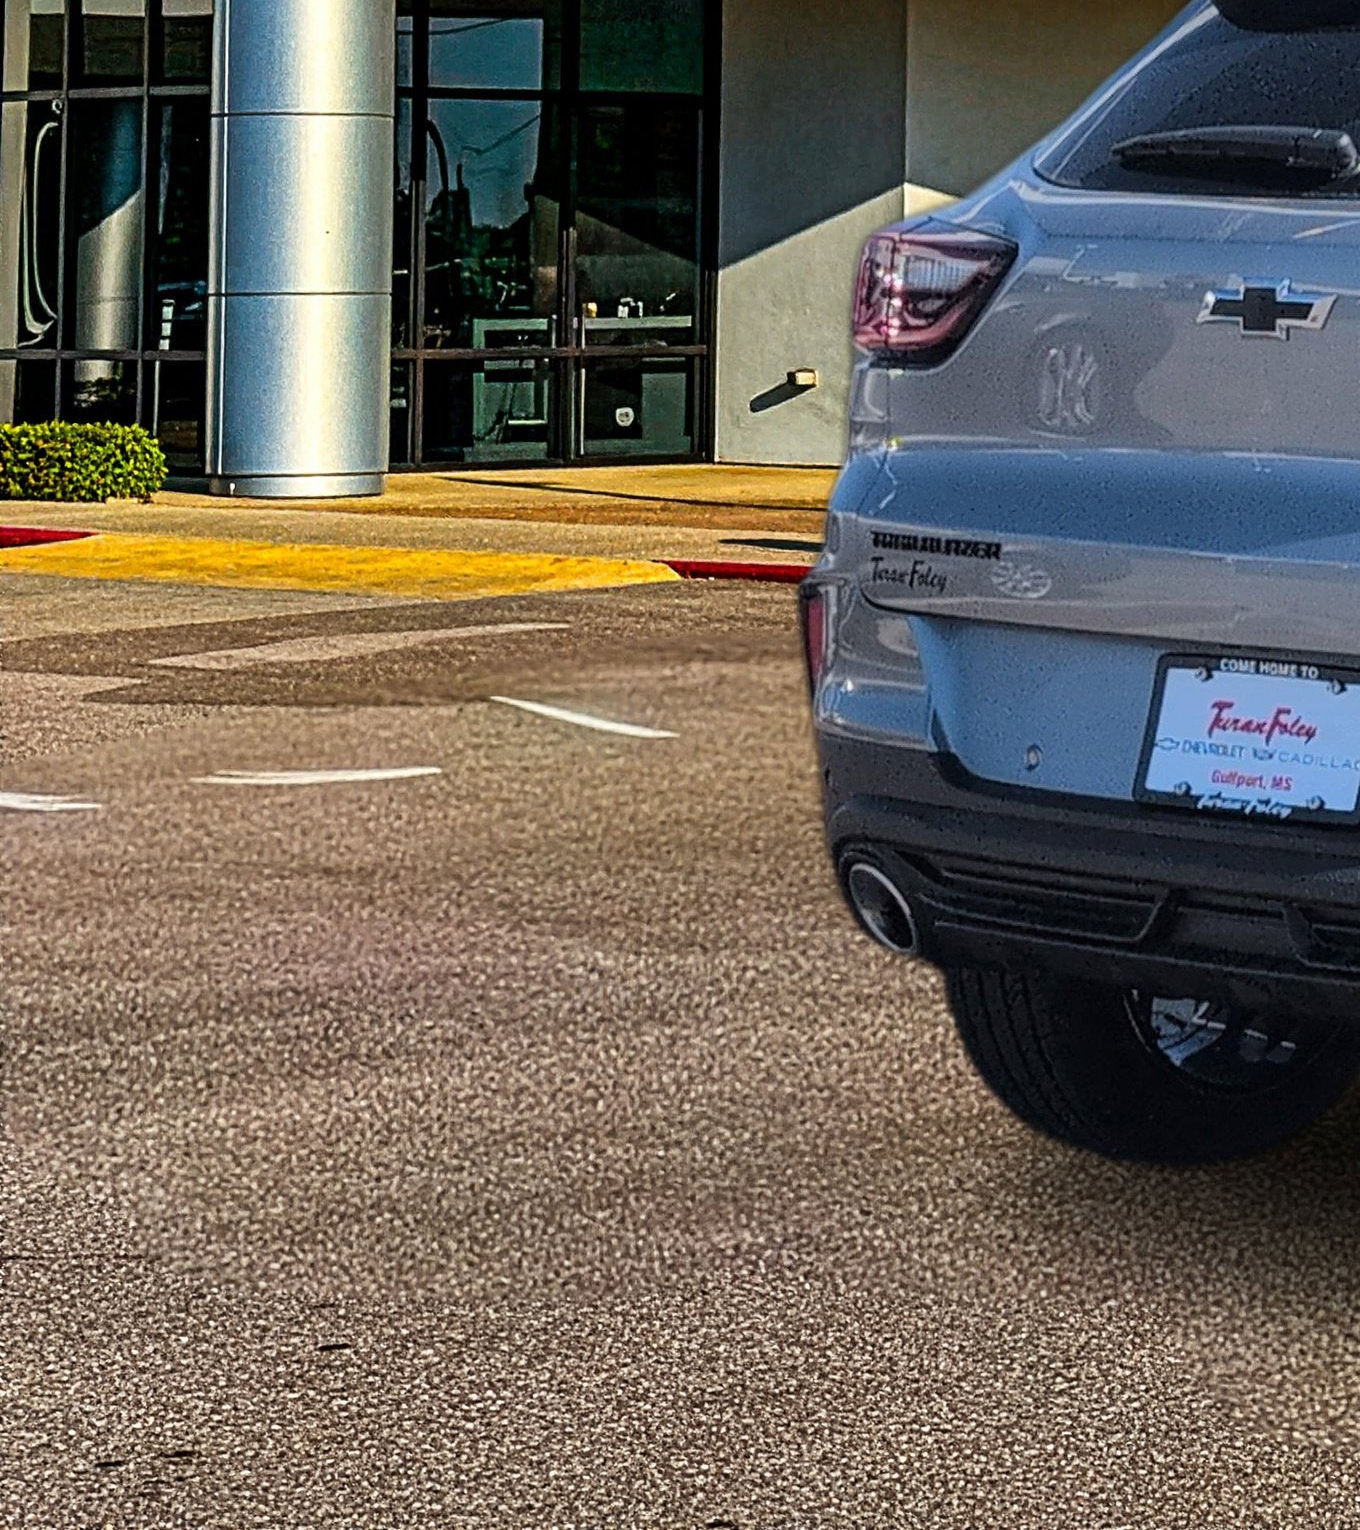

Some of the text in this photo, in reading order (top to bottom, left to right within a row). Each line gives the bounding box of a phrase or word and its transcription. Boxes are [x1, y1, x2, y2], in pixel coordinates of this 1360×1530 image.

[1220, 657, 1320, 680] COME HOME TO
[1182, 739, 1246, 758] CHEVROLET
